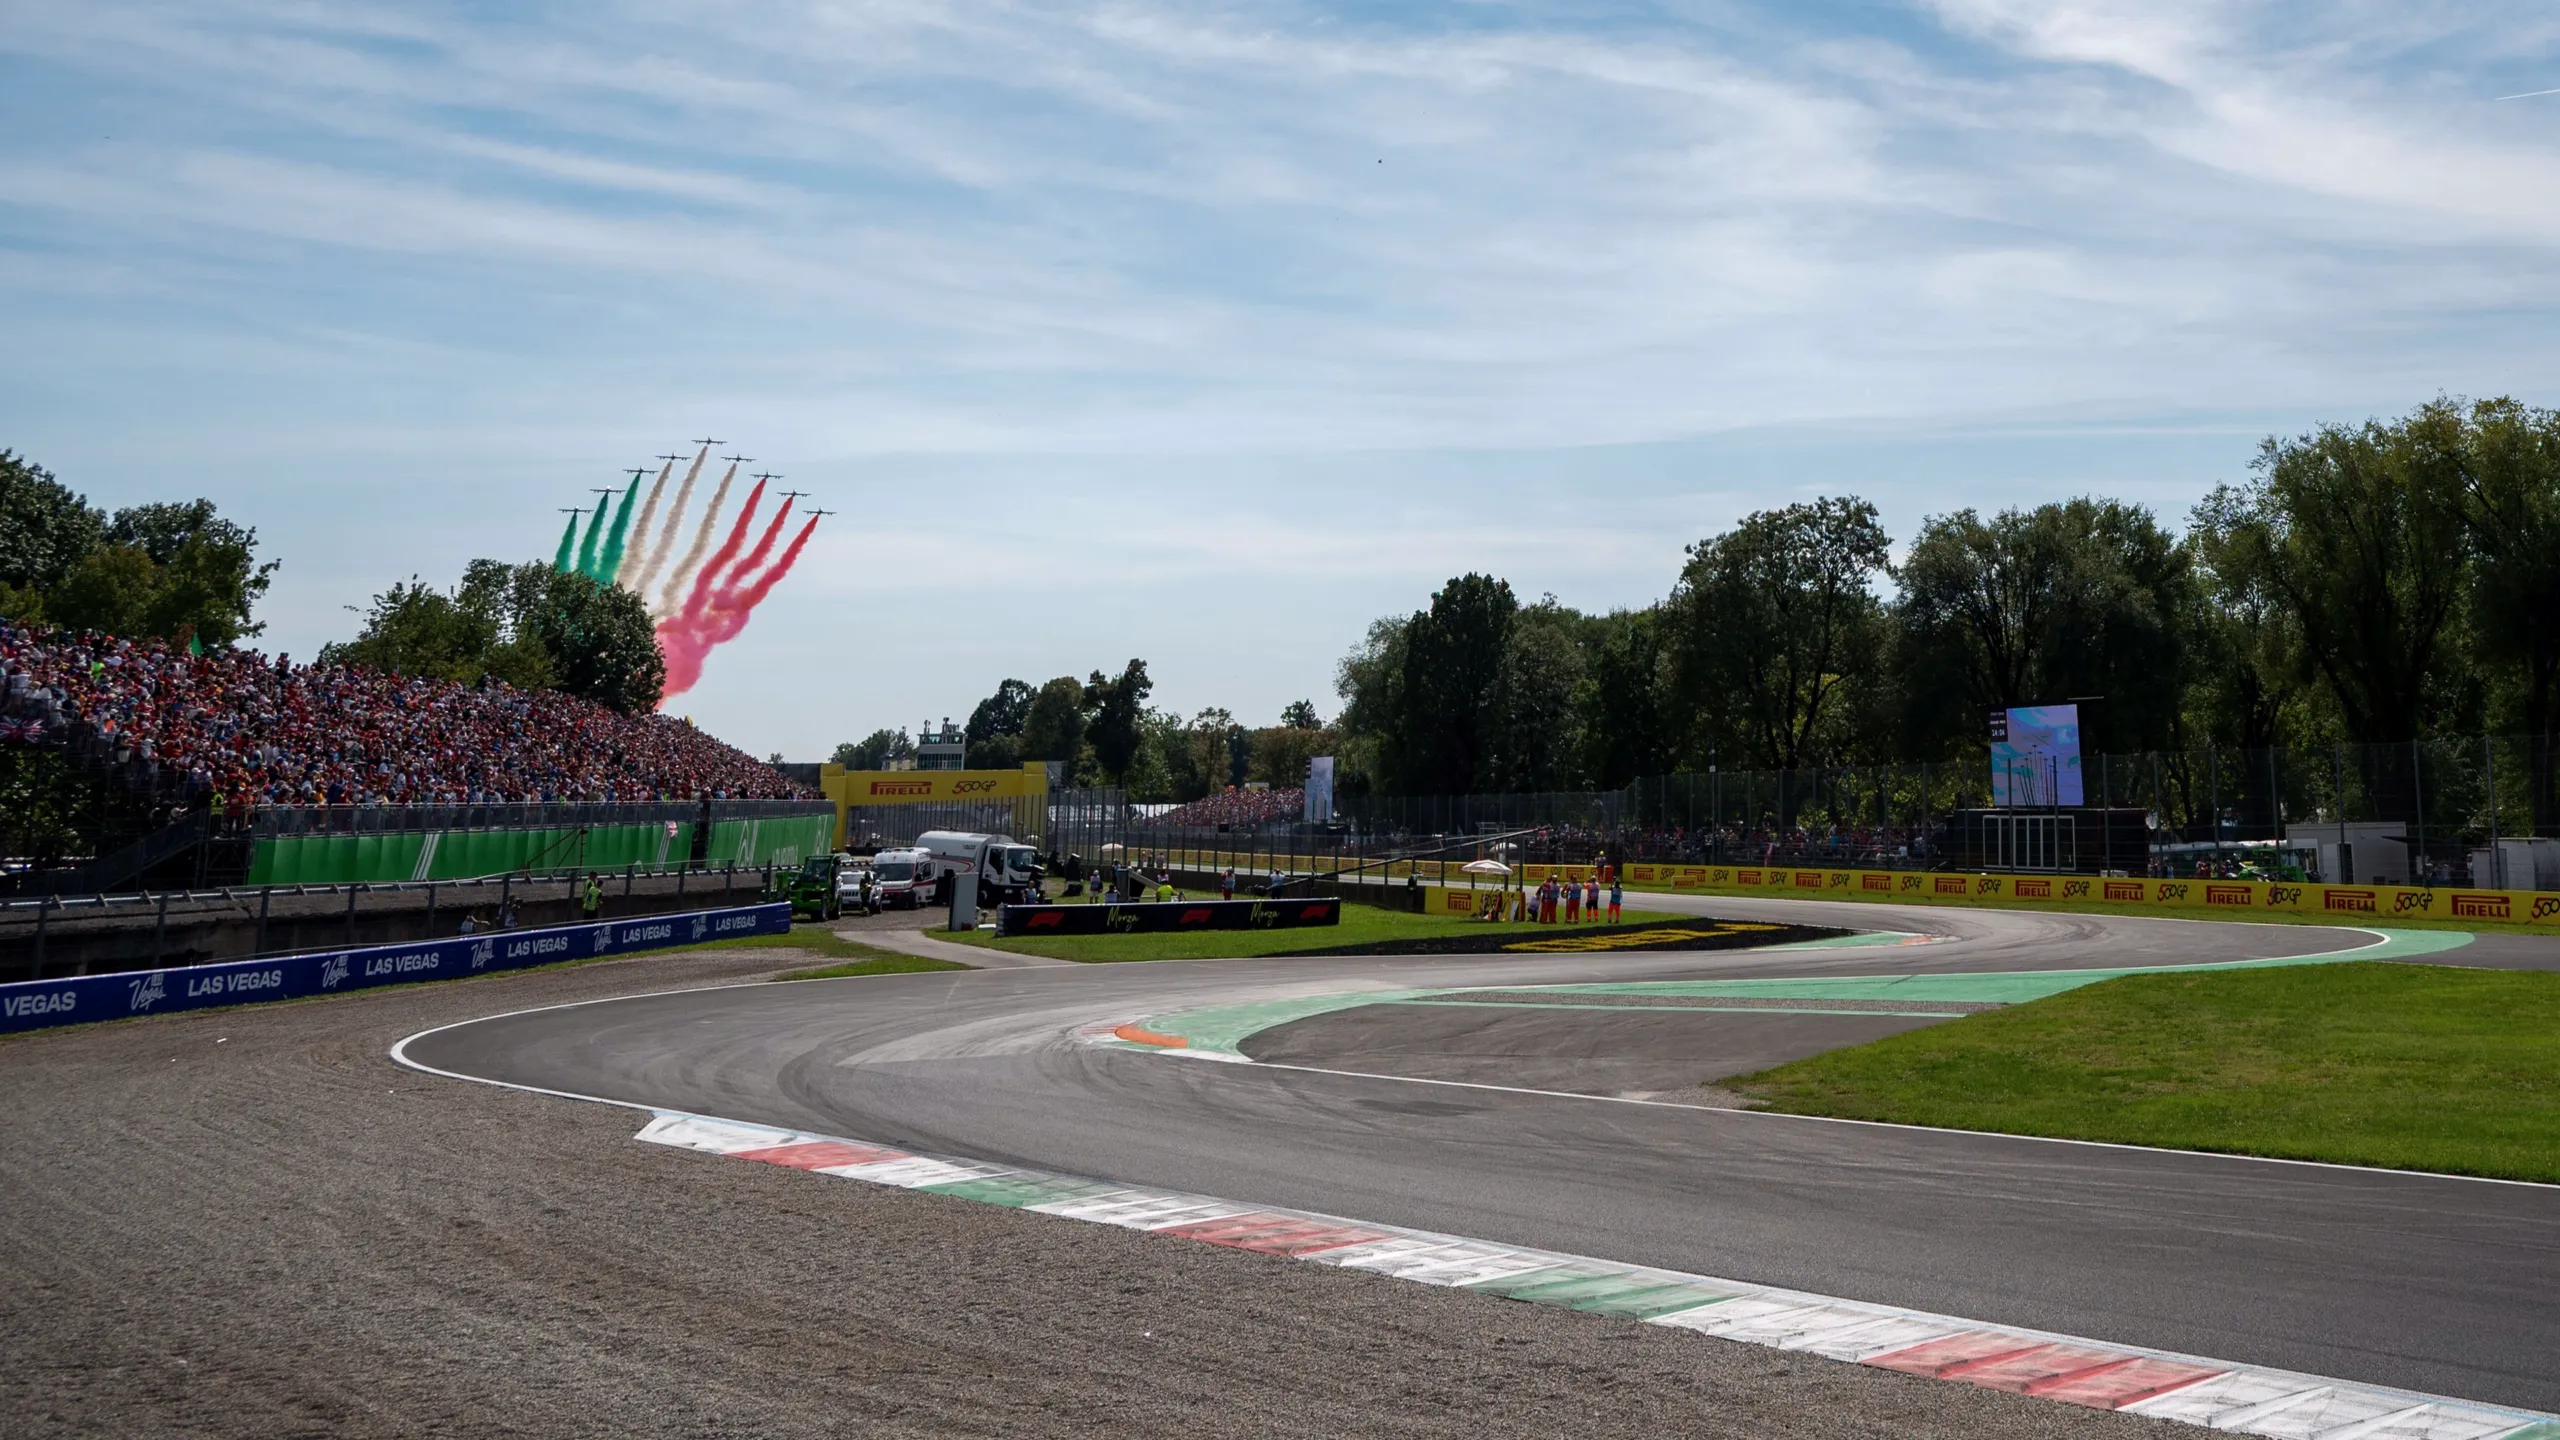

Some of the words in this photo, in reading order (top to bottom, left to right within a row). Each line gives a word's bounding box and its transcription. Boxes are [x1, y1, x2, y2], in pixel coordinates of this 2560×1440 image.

[870, 781, 932, 796] PIRELLI
[1738, 870, 1762, 885] PIRELLI
[1795, 872, 1822, 888] PIRELLI
[1862, 874, 1891, 891] PIRELLI
[1935, 877, 1967, 895] PIRELLI
[2015, 879, 2050, 897] PIRELLI
[2103, 881, 2144, 901] PIRELLI
[2206, 884, 2252, 906] PIRELLI
[2324, 889, 2376, 913] PIRELLI
[2451, 894, 2511, 919] PIRELLI
[716, 917, 731, 931] LAS
[731, 915, 756, 929] VEGAS
[623, 928, 641, 943] LAS
[642, 924, 671, 940] VEGAS
[508, 940, 531, 958] LAS
[532, 936, 568, 954] VEGAS
[365, 957, 393, 976] LAS
[395, 952, 440, 972] VEGAS
[187, 976, 224, 997] LAS
[227, 970, 282, 992] VEGAS
[5, 991, 76, 1017] VEGAS
